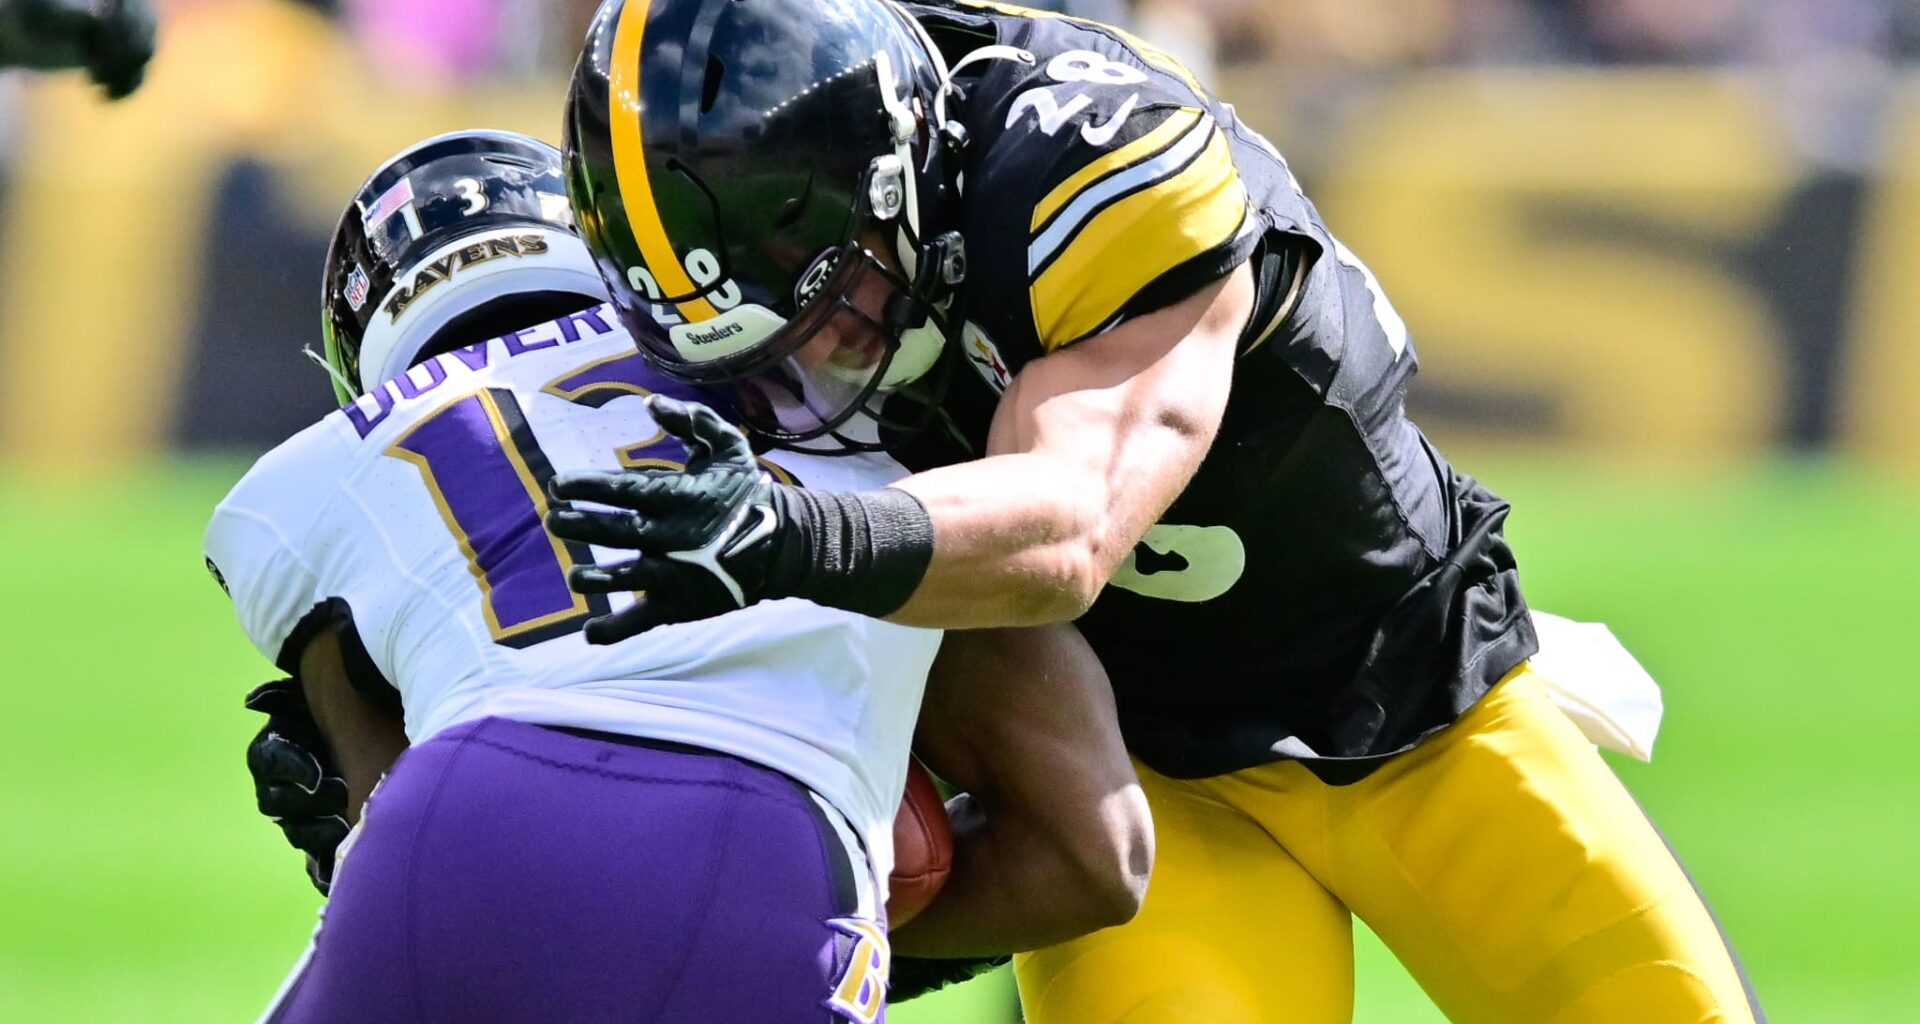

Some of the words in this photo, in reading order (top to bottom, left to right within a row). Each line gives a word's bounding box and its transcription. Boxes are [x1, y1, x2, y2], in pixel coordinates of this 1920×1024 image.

[1005, 49, 1149, 137] 28
[385, 235, 549, 325] RAVENS
[686, 322, 743, 345] Steelers
